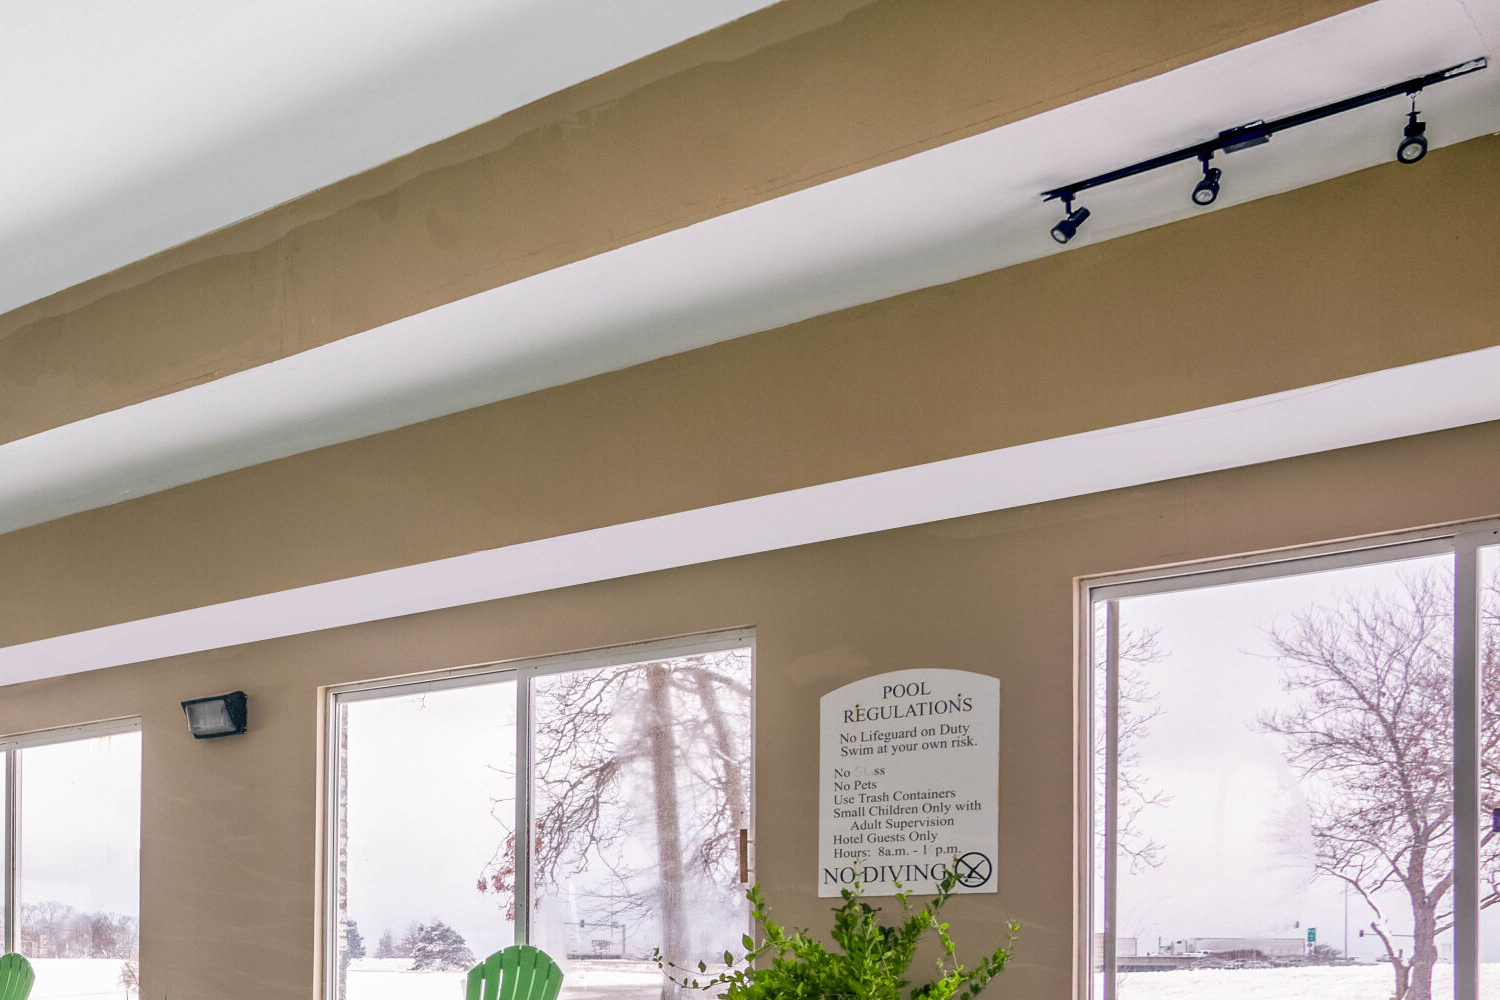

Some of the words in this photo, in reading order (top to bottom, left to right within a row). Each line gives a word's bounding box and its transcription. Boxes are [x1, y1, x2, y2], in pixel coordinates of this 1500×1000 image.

[883, 681, 931, 699] POOL
[844, 697, 972, 723] REGULATIONS
[840, 733, 856, 744] No
[861, 727, 916, 743] Lifeguard
[921, 728, 935, 737] on
[940, 724, 970, 736] Duty
[841, 745, 873, 757] Swim
[877, 743, 887, 754] at
[891, 742, 918, 755] your
[922, 740, 947, 750] own
[951, 735, 978, 748] risk.
[834, 768, 851, 778] No
[834, 781, 851, 791] No
[854, 780, 877, 790] Pets
[834, 794, 855, 805] Use
[858, 792, 889, 804] Trash
[893, 789, 956, 801] Containers
[833, 806, 865, 818] Small
[869, 804, 918, 816] Children
[922, 802, 951, 814] Only
[955, 800, 982, 811] with
[850, 819, 881, 830] Adult
[885, 816, 955, 830] Supervision
[833, 834, 863, 845] Hotel
[867, 832, 905, 843] Guests
[909, 830, 938, 843] Only
[834, 847, 870, 858] Hours:
[878, 846, 909, 857] 8a.m.
[823, 867, 856, 885] NO
[863, 863, 947, 883] DIVING
